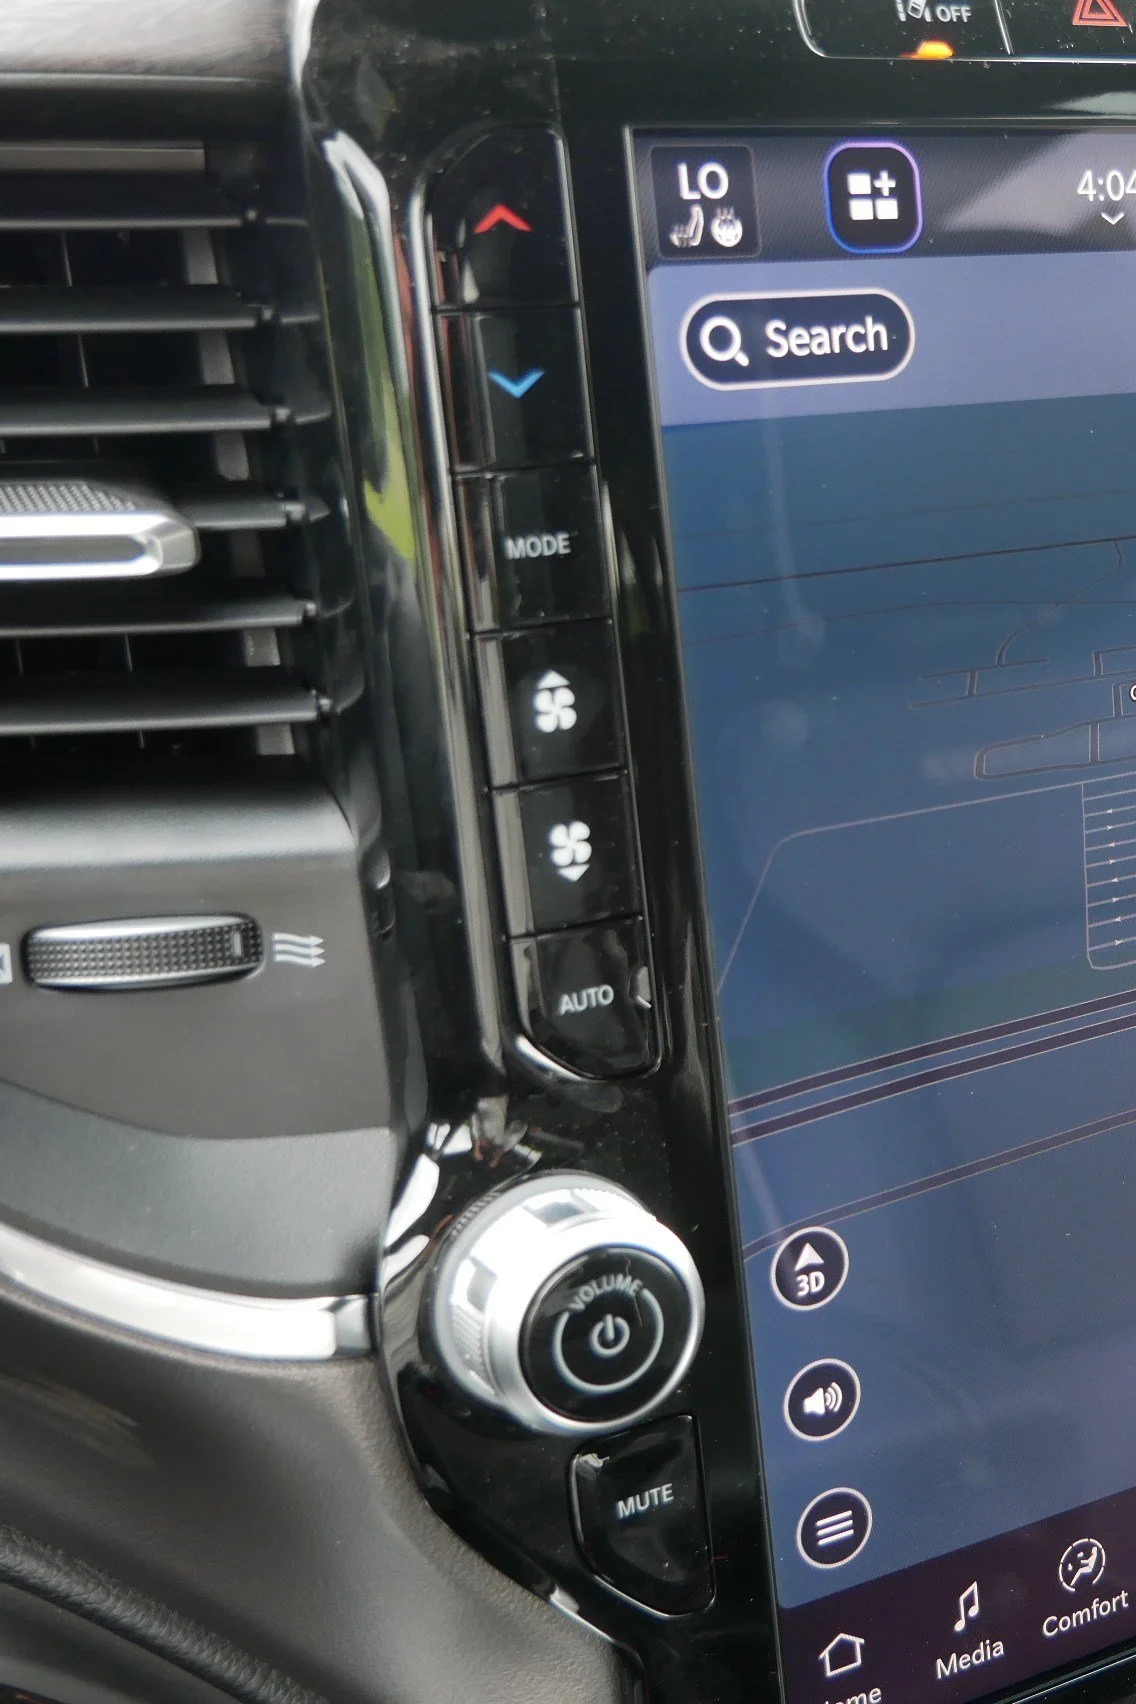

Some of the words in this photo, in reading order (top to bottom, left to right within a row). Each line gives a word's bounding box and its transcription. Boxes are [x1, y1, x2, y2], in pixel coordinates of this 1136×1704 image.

[936, 6, 971, 22] OFF
[677, 162, 729, 200] LO
[765, 315, 889, 358] Search
[505, 532, 571, 559] MODE
[558, 984, 614, 1016] AUTO
[568, 1273, 643, 1311] VOLUME
[797, 1271, 825, 1297] 3D
[616, 1483, 674, 1520] MUTE
[1042, 1590, 1129, 1638] Comfort
[935, 1637, 1005, 1680] Media
